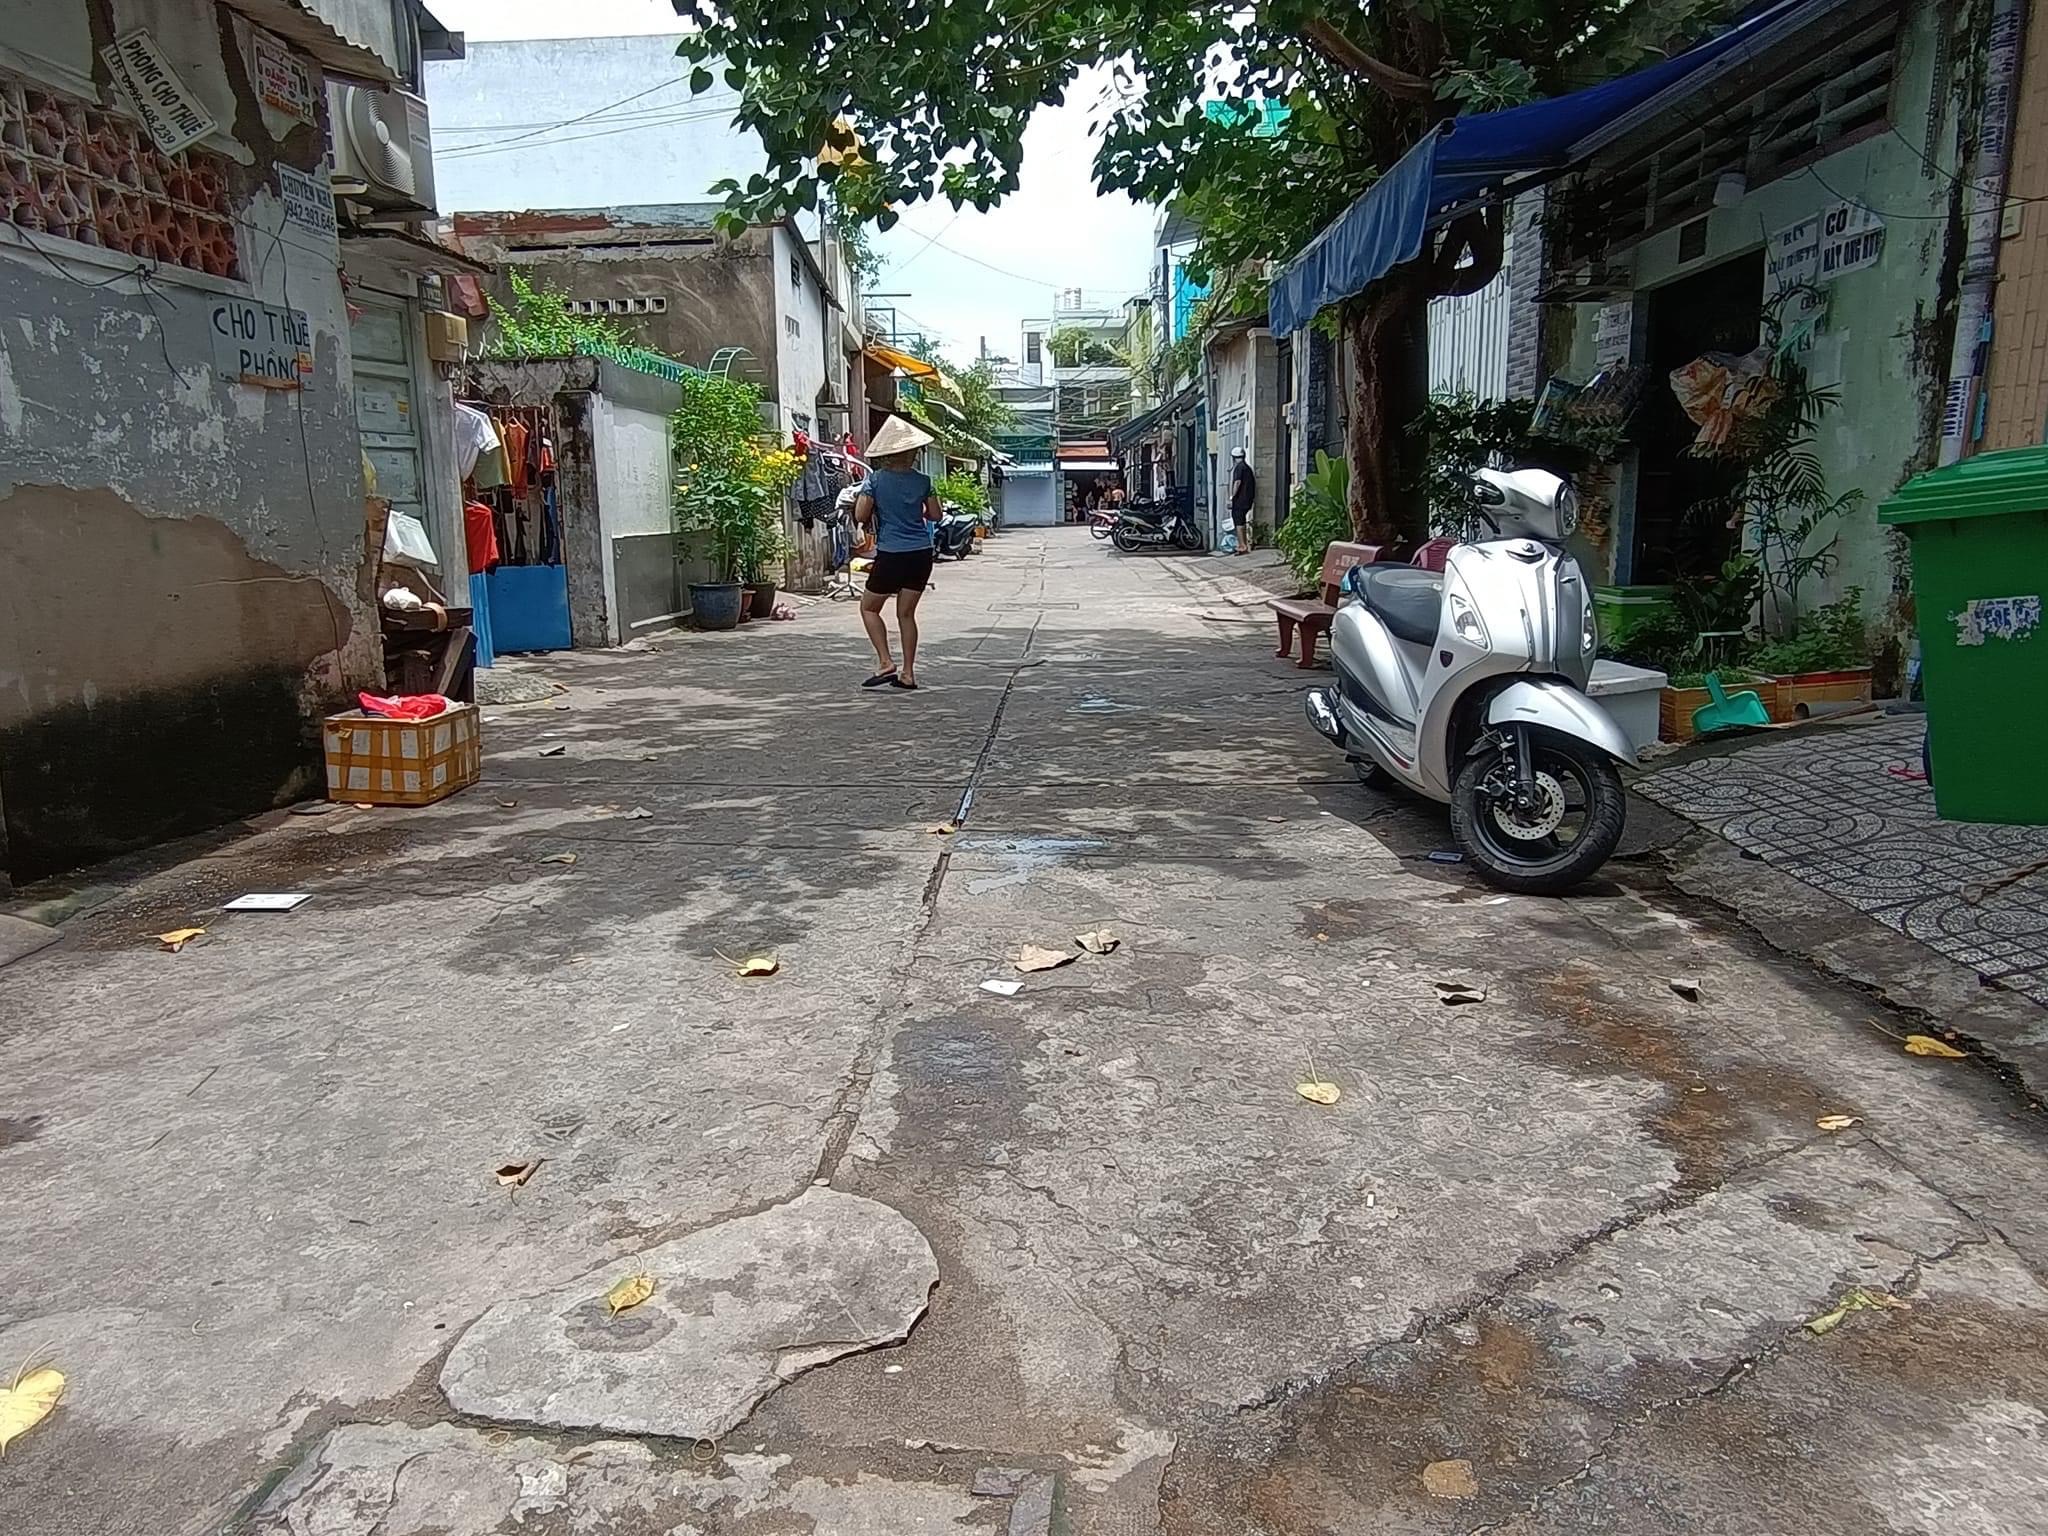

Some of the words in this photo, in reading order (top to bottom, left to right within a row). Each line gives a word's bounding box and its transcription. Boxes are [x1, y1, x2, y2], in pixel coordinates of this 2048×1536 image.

[151, 80, 181, 107] CHO
[213, 303, 256, 340] CHO
[264, 311, 311, 347] THUÊ
